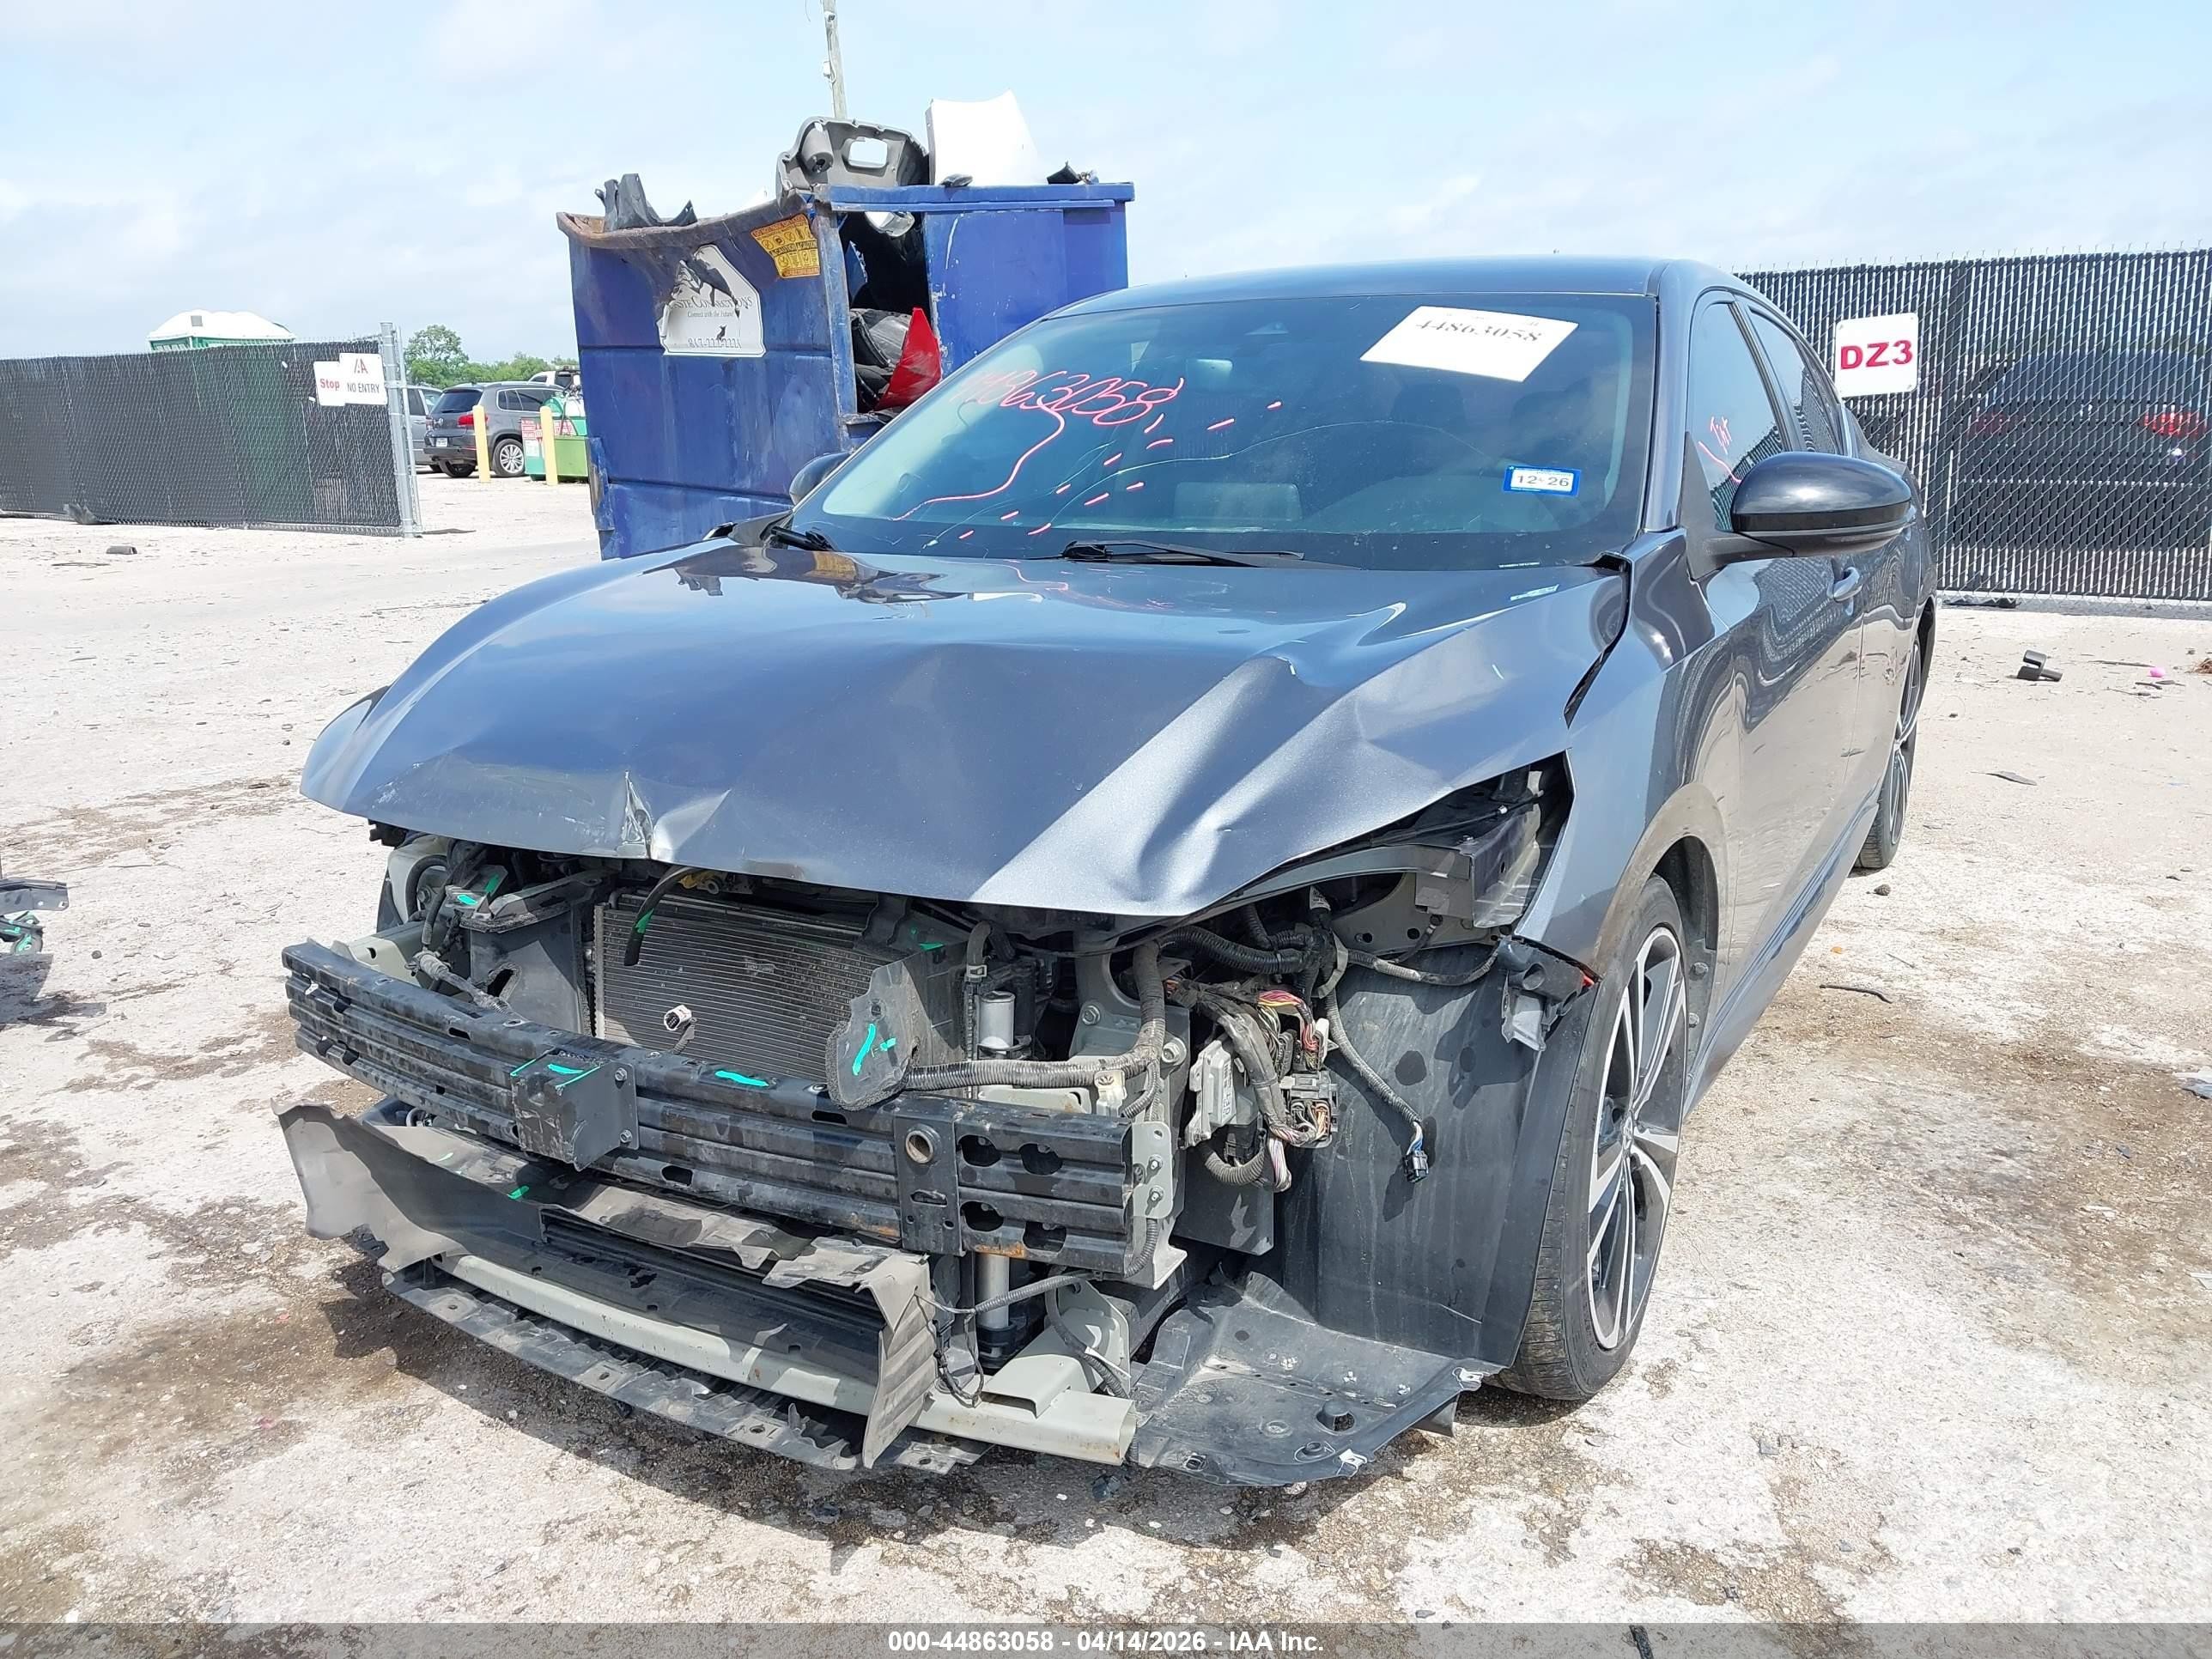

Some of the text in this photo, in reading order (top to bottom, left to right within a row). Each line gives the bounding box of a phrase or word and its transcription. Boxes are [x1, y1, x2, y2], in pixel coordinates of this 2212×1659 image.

[1840, 339, 1913, 370] DZ3
[319, 378, 340, 391] Stop
[346, 382, 380, 393] NO ENTRY
